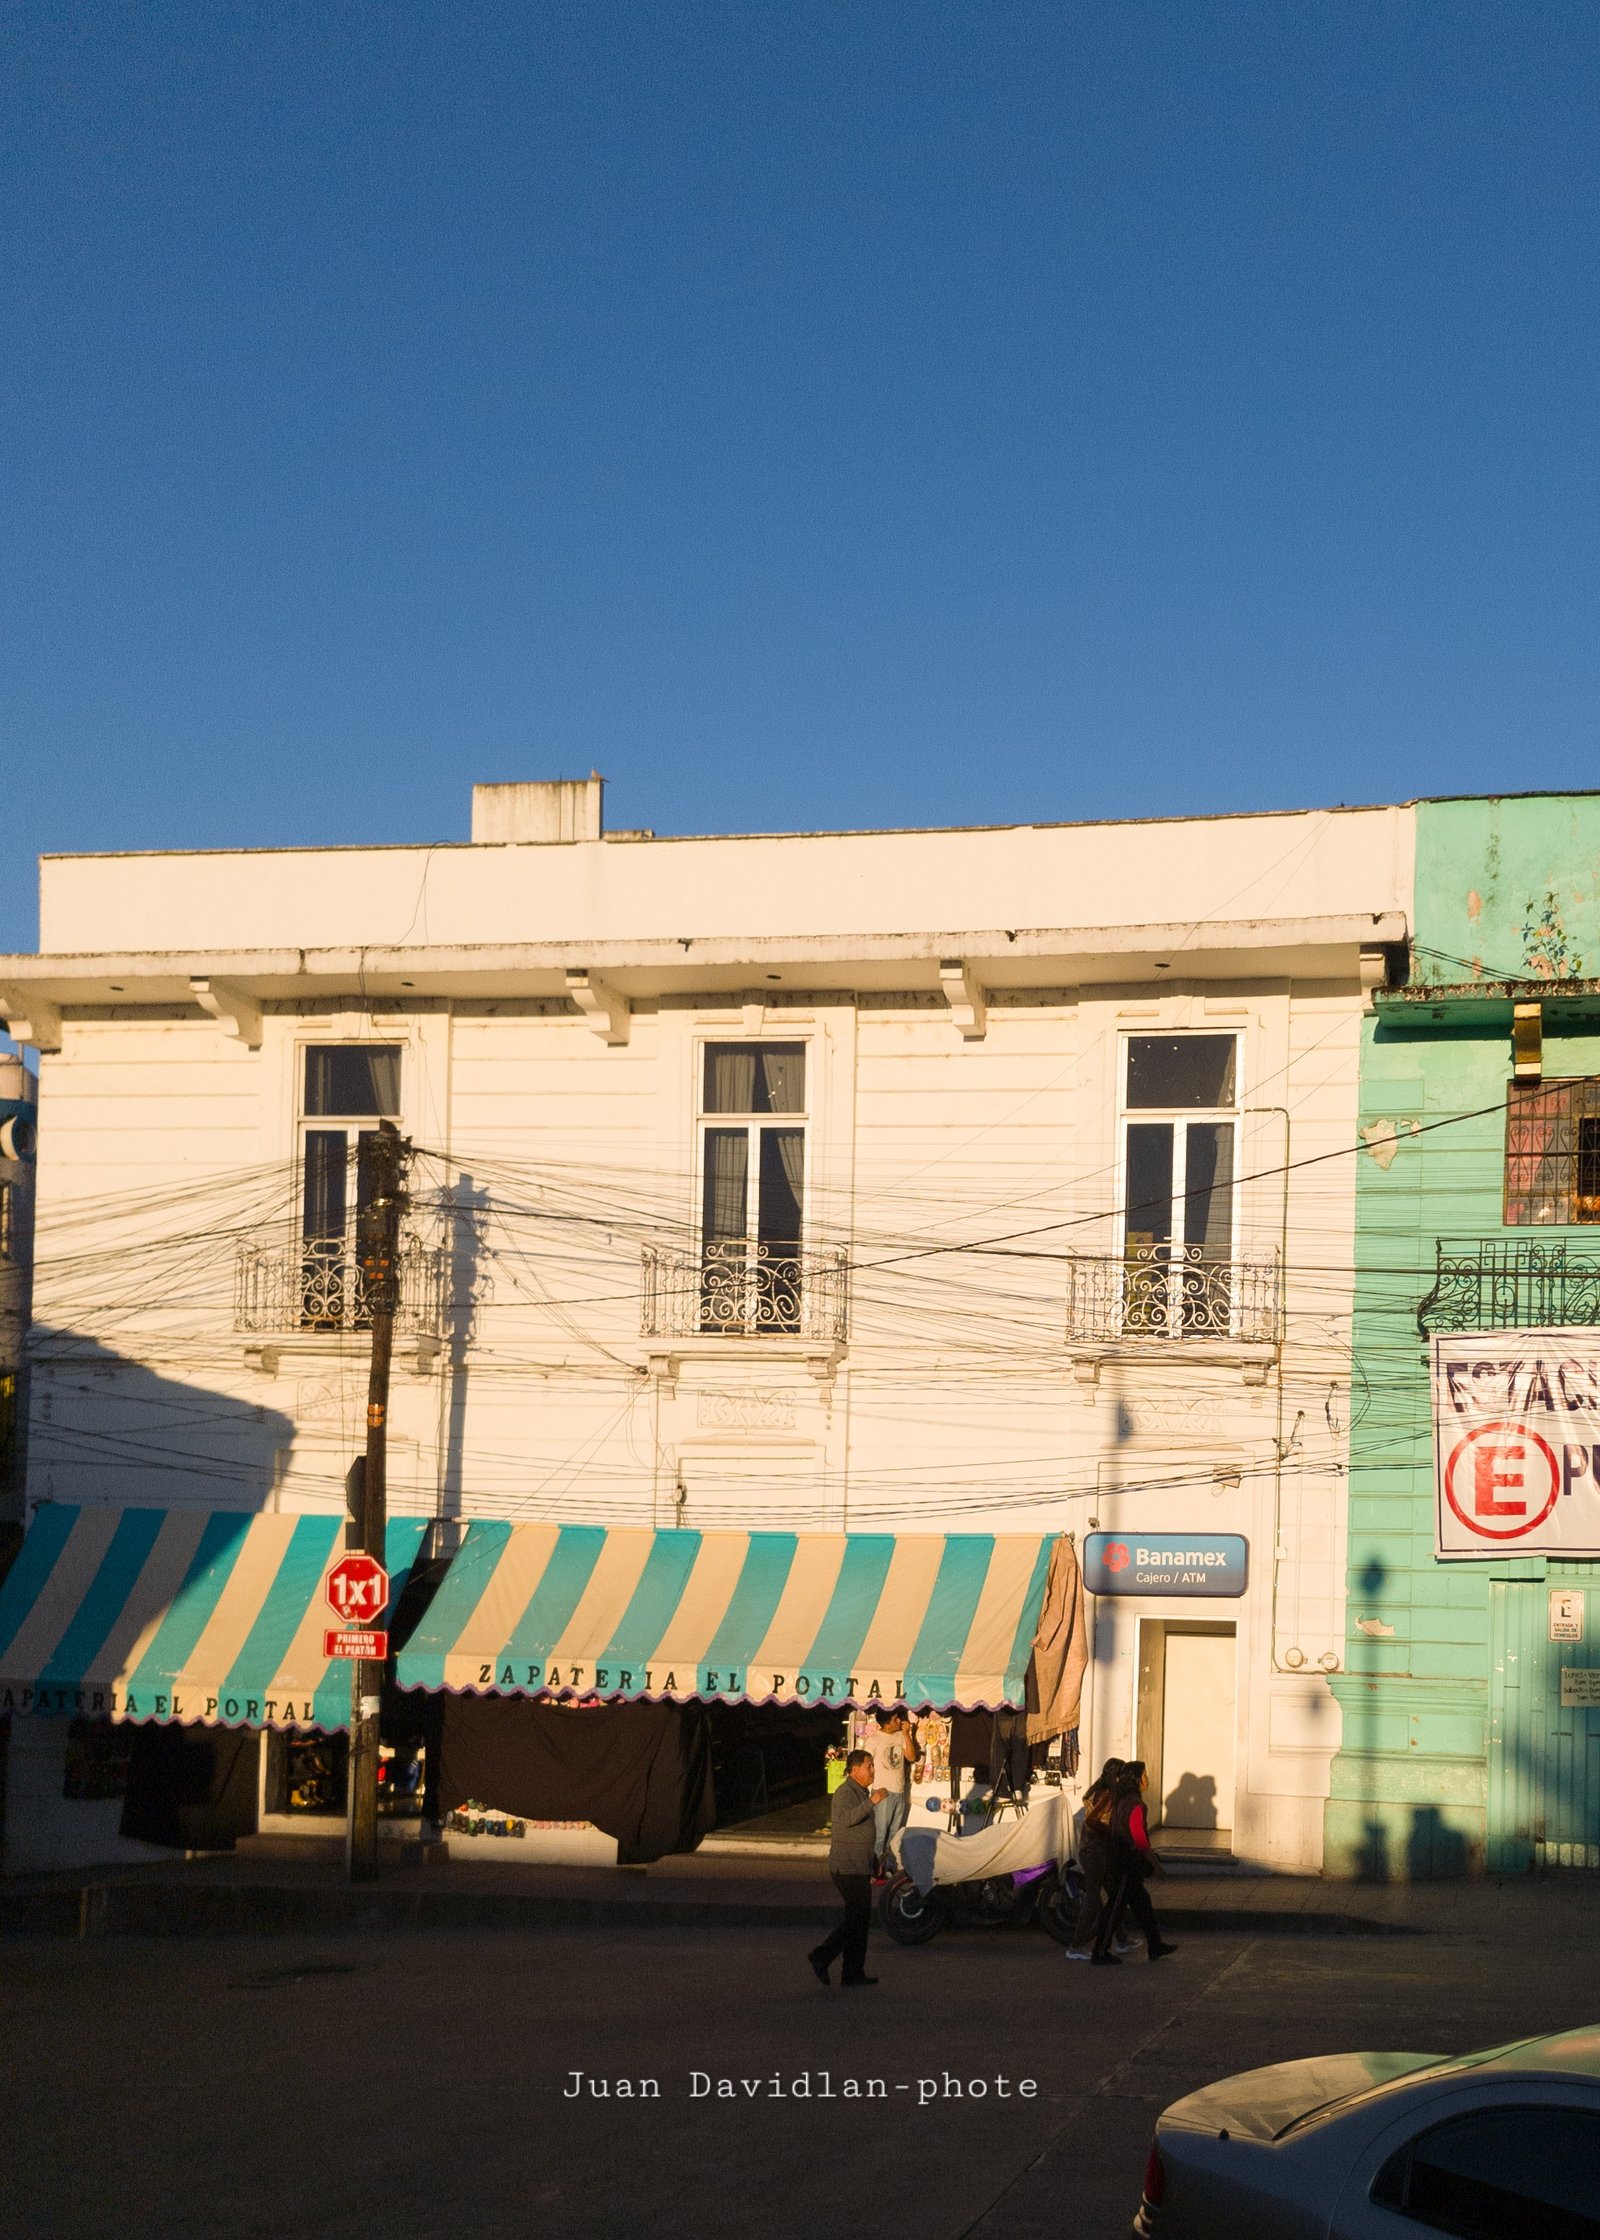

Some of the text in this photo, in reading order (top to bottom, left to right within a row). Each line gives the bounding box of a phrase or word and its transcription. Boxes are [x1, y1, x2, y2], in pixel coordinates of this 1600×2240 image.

[1475, 1445, 1527, 1516] E
[1136, 1547, 1227, 1567] Banamex
[333, 1573, 382, 1606] 1x1
[1136, 1572, 1171, 1586] Cajero
[1181, 1572, 1206, 1583] ATM
[334, 1644, 344, 1654] EL
[336, 1633, 375, 1645] PRIMERO
[478, 1662, 909, 1700] ZAPATERIA EL PORTAL
[154, 1694, 184, 1715] EL
[205, 1696, 317, 1721] PORTAL
